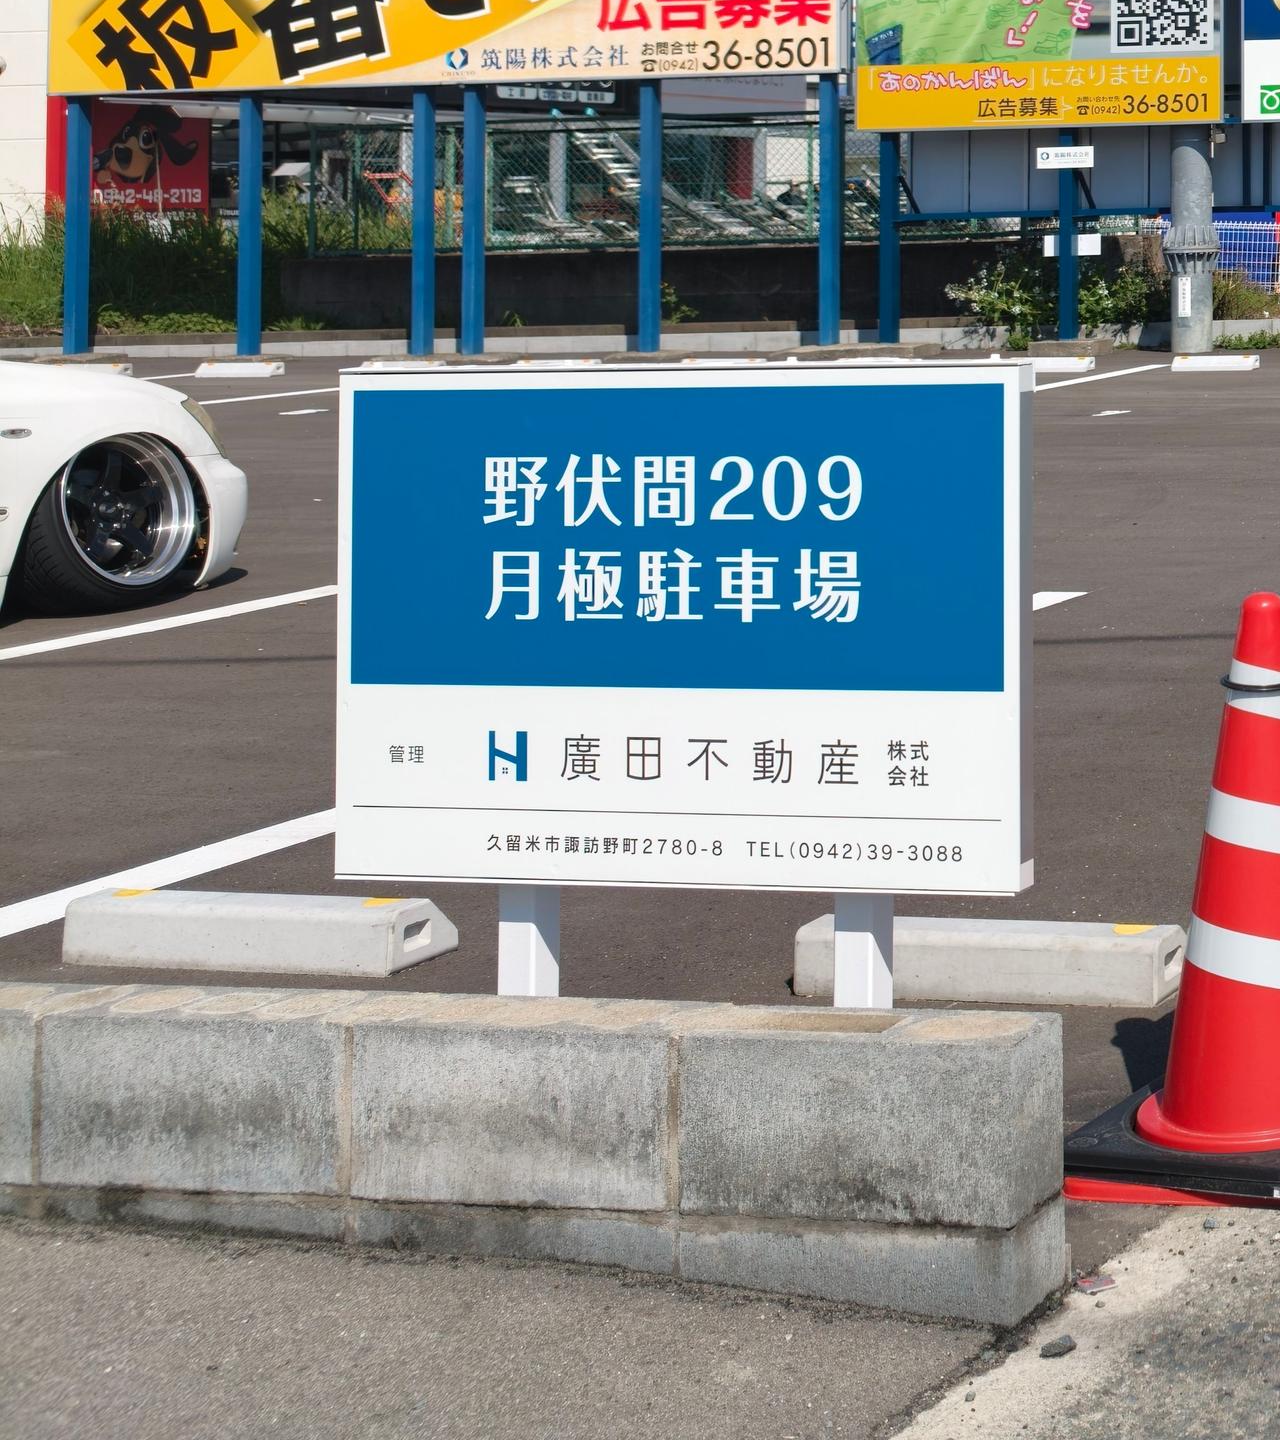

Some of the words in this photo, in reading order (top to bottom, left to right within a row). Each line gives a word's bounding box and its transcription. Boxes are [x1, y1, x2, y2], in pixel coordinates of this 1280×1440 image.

[481, 45, 629, 70] 筑陽株式会社
[641, 41, 699, 56] お問合せ
[659, 58, 699, 73] (0942)
[702, 37, 830, 71] 36-8501
[977, 96, 1058, 118] 広告募集
[1091, 104, 1121, 116] (0942)
[1123, 93, 1209, 115] 36-8501
[481, 453, 864, 528] 野伏間209
[485, 548, 862, 623] 月極駐車場
[388, 745, 425, 764] 管理
[560, 734, 860, 786] 廣田不動産
[887, 740, 930, 762] 株式
[887, 765, 930, 788] 会社
[746, 840, 964, 863] TEL(0942)39-3088
